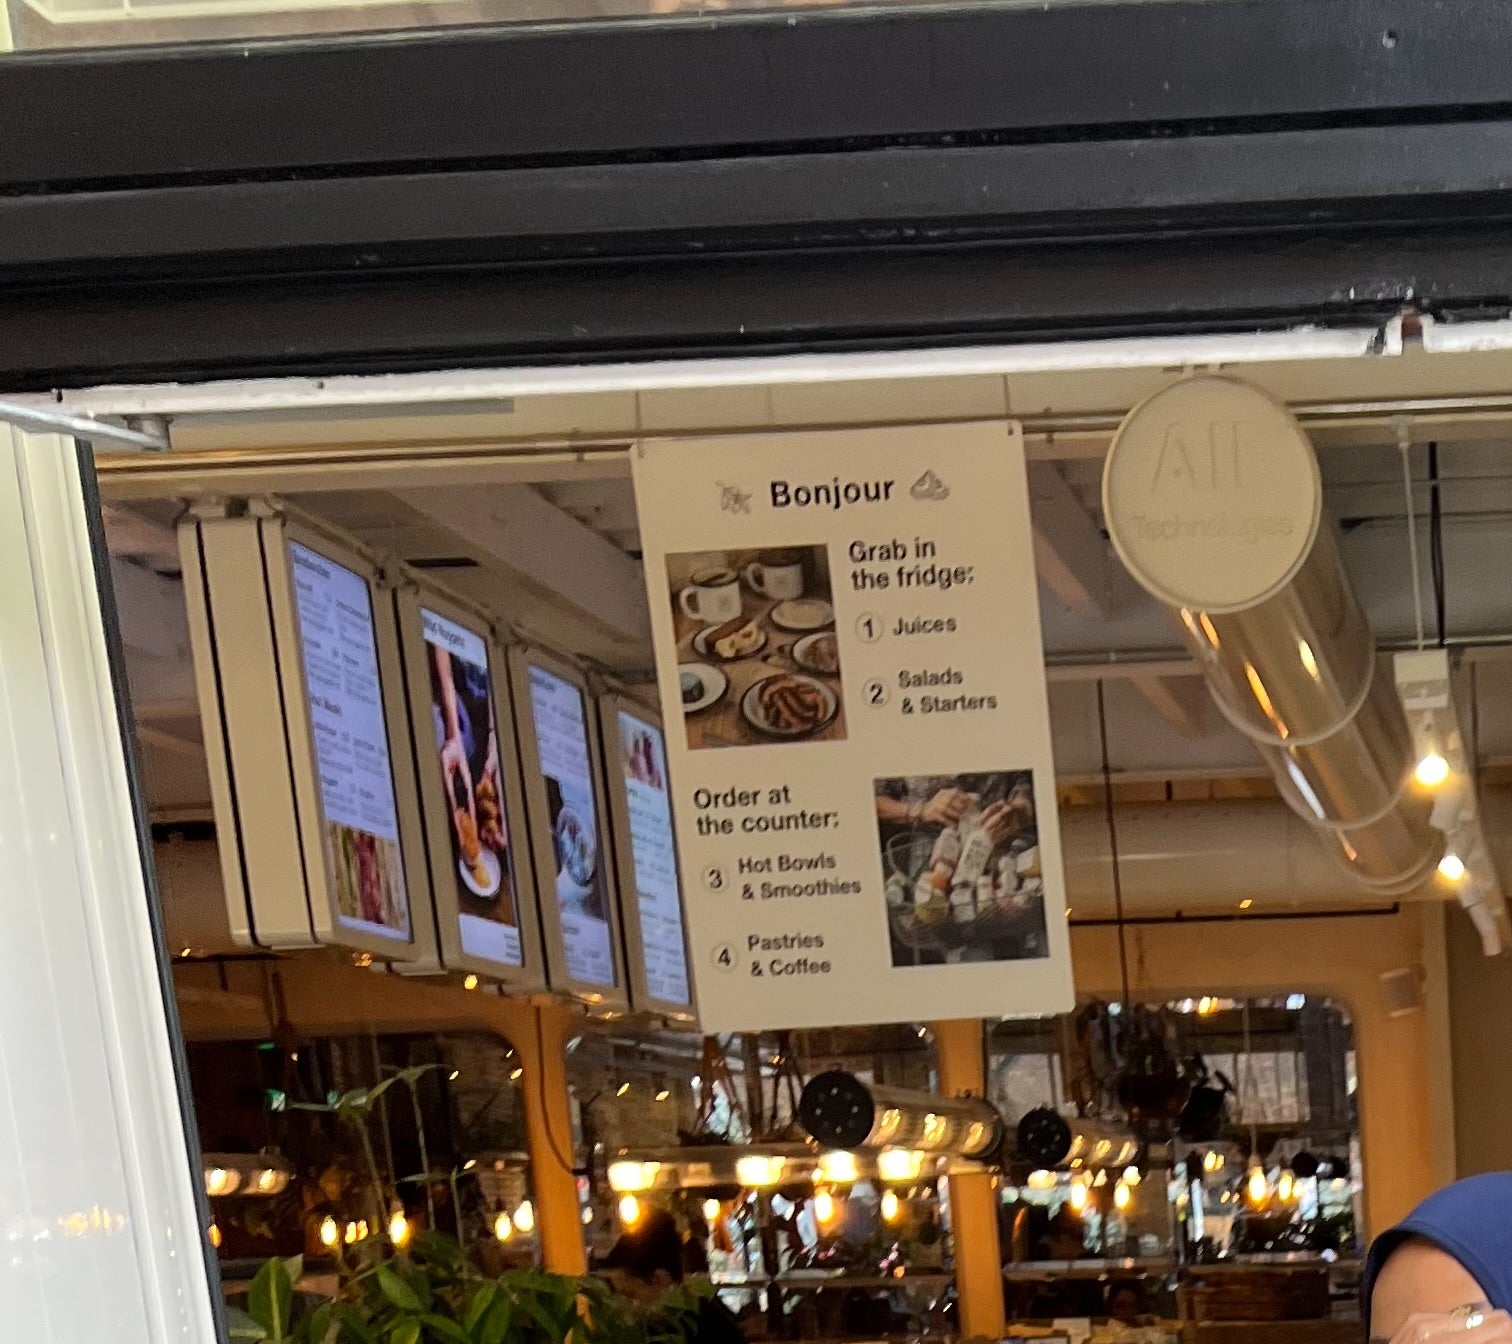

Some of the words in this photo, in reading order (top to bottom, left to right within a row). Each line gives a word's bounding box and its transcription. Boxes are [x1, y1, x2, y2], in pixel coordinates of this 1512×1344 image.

[770, 477, 895, 511] Bonjour
[849, 538, 907, 563] Grab
[914, 536, 937, 559] in
[851, 567, 890, 590] the
[897, 564, 976, 590] fridge:
[863, 618, 874, 638] 1
[893, 615, 958, 636] Juices
[898, 667, 964, 689] Salads
[869, 683, 884, 704] 2
[901, 697, 914, 715] &
[920, 694, 998, 714] Starters
[693, 785, 761, 810] Order
[768, 784, 792, 805] at
[696, 814, 734, 836] the
[741, 810, 840, 833] counter:
[737, 855, 773, 874] Hot
[778, 852, 837, 872] Bowls
[708, 869, 723, 889] 3
[741, 883, 755, 901] &
[760, 876, 862, 901] Smoothies
[747, 932, 825, 951] Pastries
[717, 948, 732, 967] 4
[751, 960, 764, 977] &
[769, 958, 832, 977] Coffee
